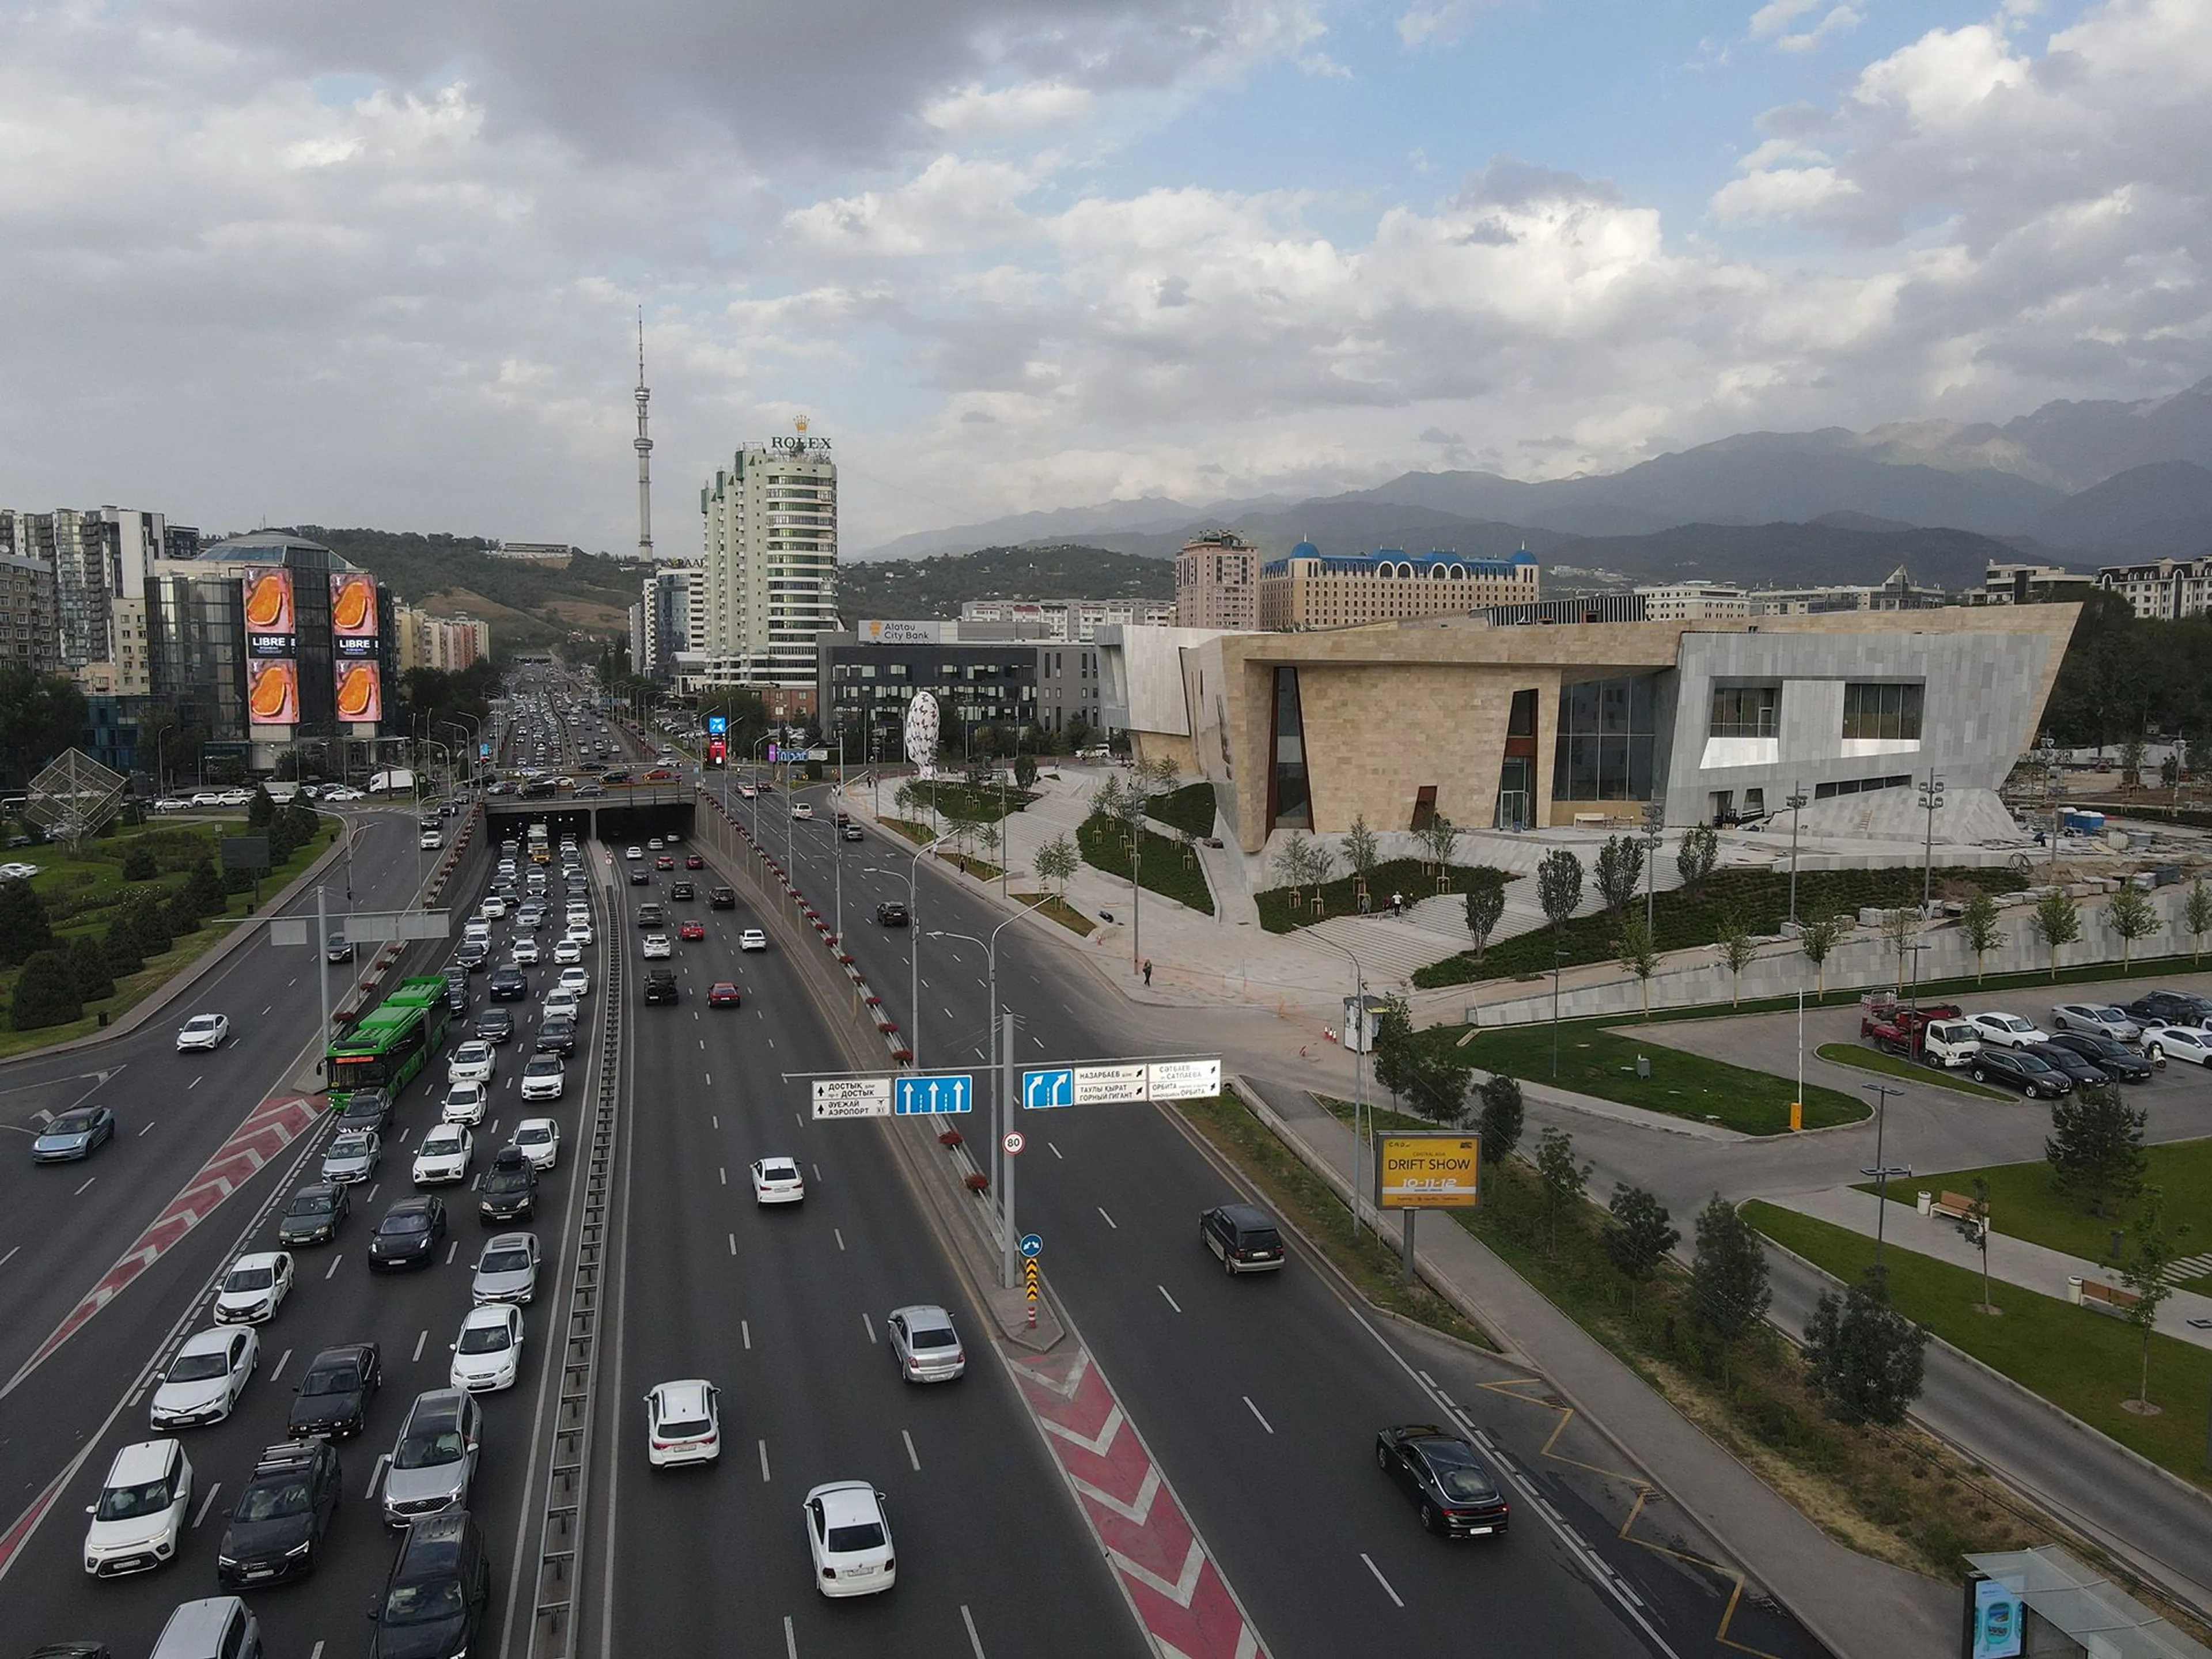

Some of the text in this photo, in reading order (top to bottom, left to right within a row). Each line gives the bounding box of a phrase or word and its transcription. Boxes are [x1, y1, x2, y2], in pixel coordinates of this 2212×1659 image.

[771, 437, 832, 449] ROLEX
[884, 631, 903, 641] City
[252, 637, 286, 646] LIBRE
[339, 639, 370, 648] LIBRE
[1080, 1071, 1120, 1080] НАЗАРБАЕВ
[1007, 1138, 1020, 1147] 80
[1388, 1159, 1471, 1170] DRIFT SHOW
[1403, 1178, 1457, 1187] 10-11-12
